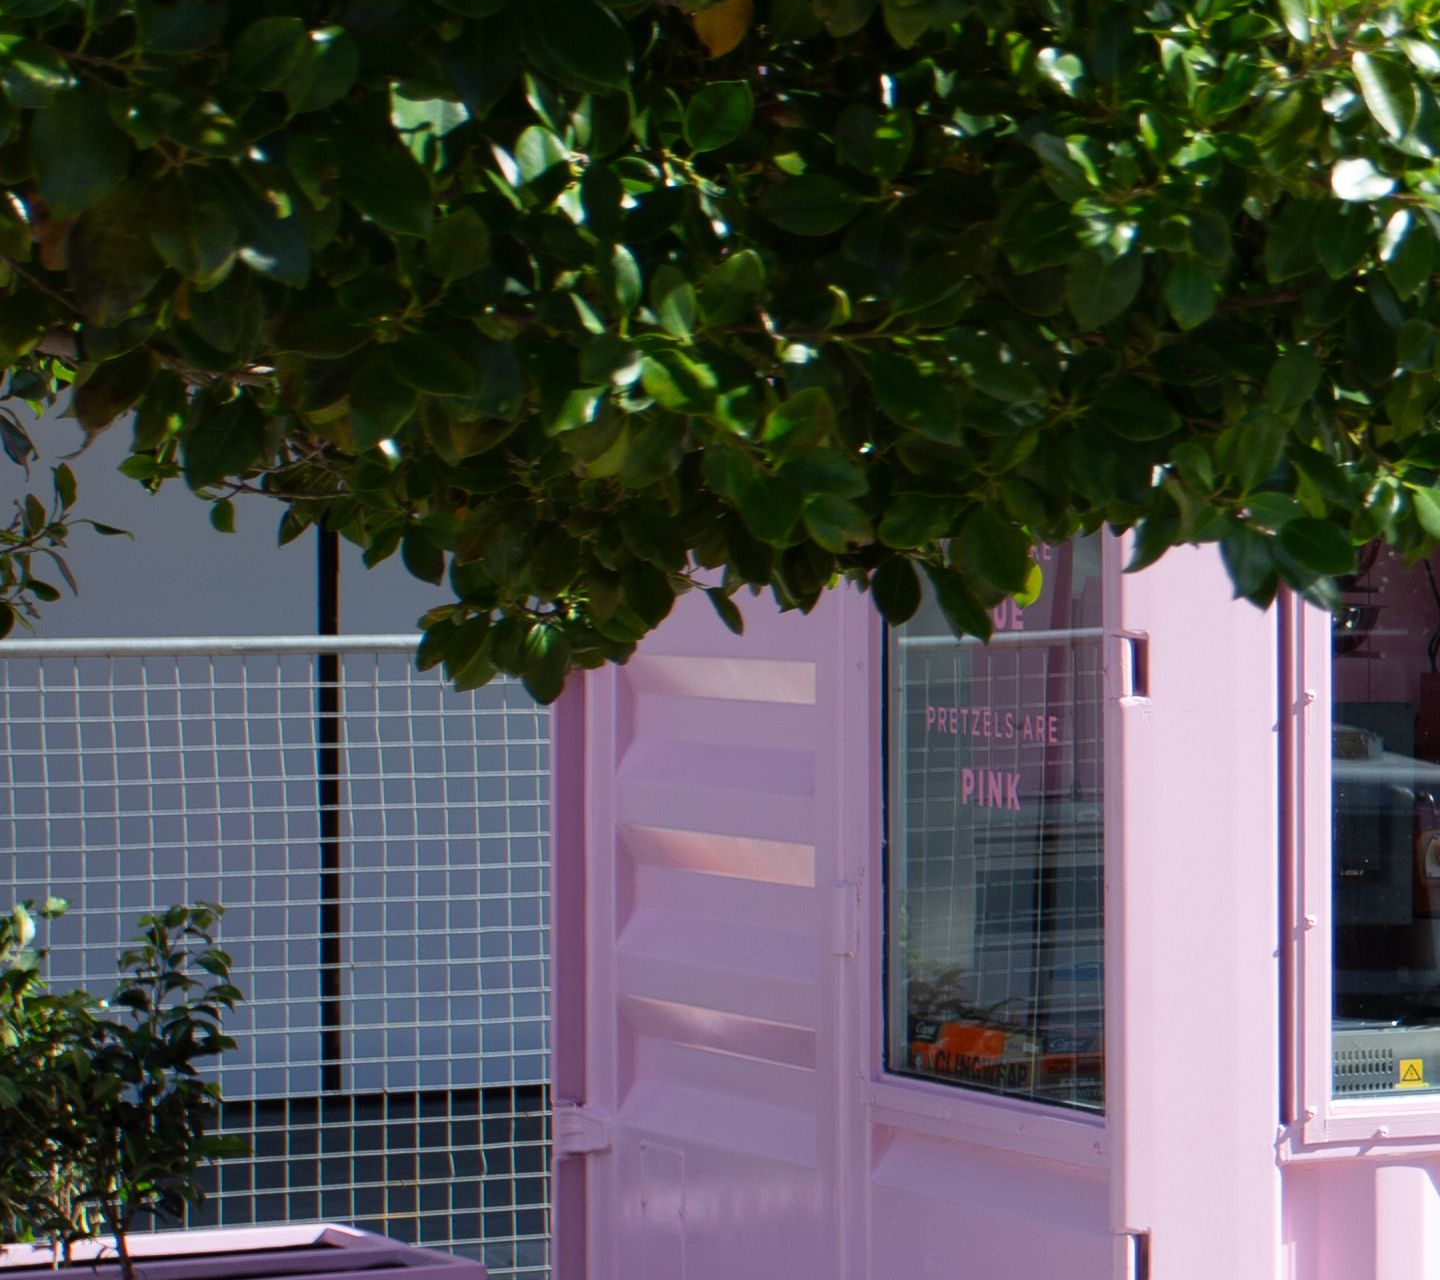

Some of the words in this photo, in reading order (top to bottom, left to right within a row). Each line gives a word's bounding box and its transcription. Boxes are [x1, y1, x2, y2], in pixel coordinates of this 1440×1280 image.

[926, 706, 1014, 739] PRETZELS
[1022, 714, 1058, 743] ARE
[961, 768, 1021, 811] PINK
